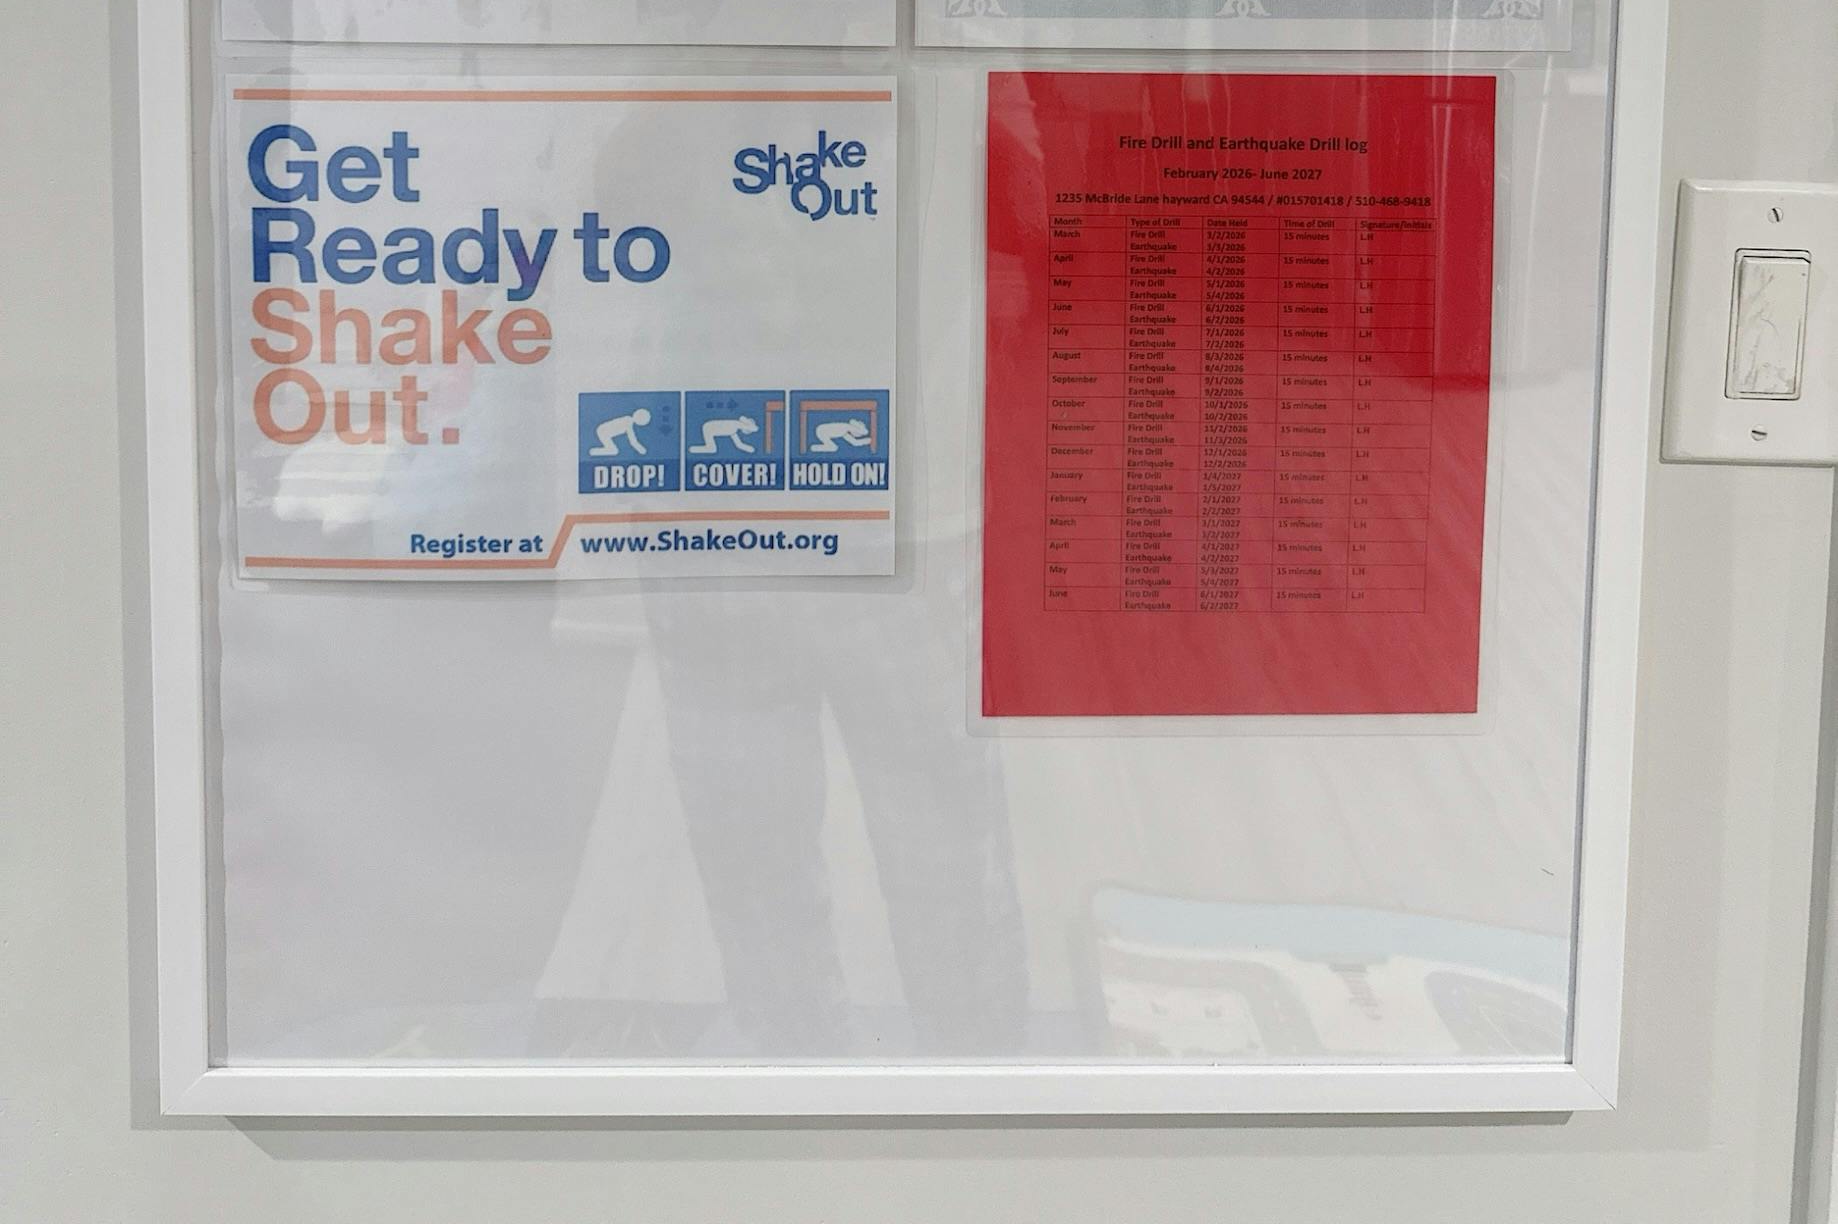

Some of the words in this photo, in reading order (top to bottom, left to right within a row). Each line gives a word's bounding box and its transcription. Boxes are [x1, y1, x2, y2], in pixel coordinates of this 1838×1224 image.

[1119, 135, 1147, 149] Fire
[1151, 135, 1182, 150] Drill
[1186, 135, 1214, 150] and
[1217, 135, 1305, 153] Earthquake
[1309, 136, 1340, 151] Drill
[1342, 137, 1368, 154] log
[247, 123, 420, 203] Get
[732, 129, 867, 195] Shake
[1163, 167, 1219, 181] February
[1221, 167, 1258, 180] 2026-
[1259, 168, 1289, 181] June
[1291, 168, 1323, 181] 2027
[790, 178, 878, 221] Out
[1055, 193, 1083, 204] 1235
[1085, 192, 1132, 205] McBride
[1133, 193, 1160, 205] Lane
[1162, 193, 1211, 207] hayward
[1212, 194, 1228, 205] CA
[1230, 194, 1266, 206] 94544
[1275, 194, 1344, 207] #015701418
[1354, 195, 1432, 207] 510-468-9418
[251, 207, 557, 302] Ready
[573, 211, 671, 284] to
[250, 289, 553, 366] Shake
[253, 368, 461, 447] Out.
[593, 464, 666, 490] DROP!
[693, 463, 777, 489] COVER!
[792, 462, 846, 489] HOLD
[850, 462, 886, 488] ON!
[409, 532, 514, 559] Register
[518, 534, 544, 555] at
[580, 529, 840, 558] www.ShakeOut.org
